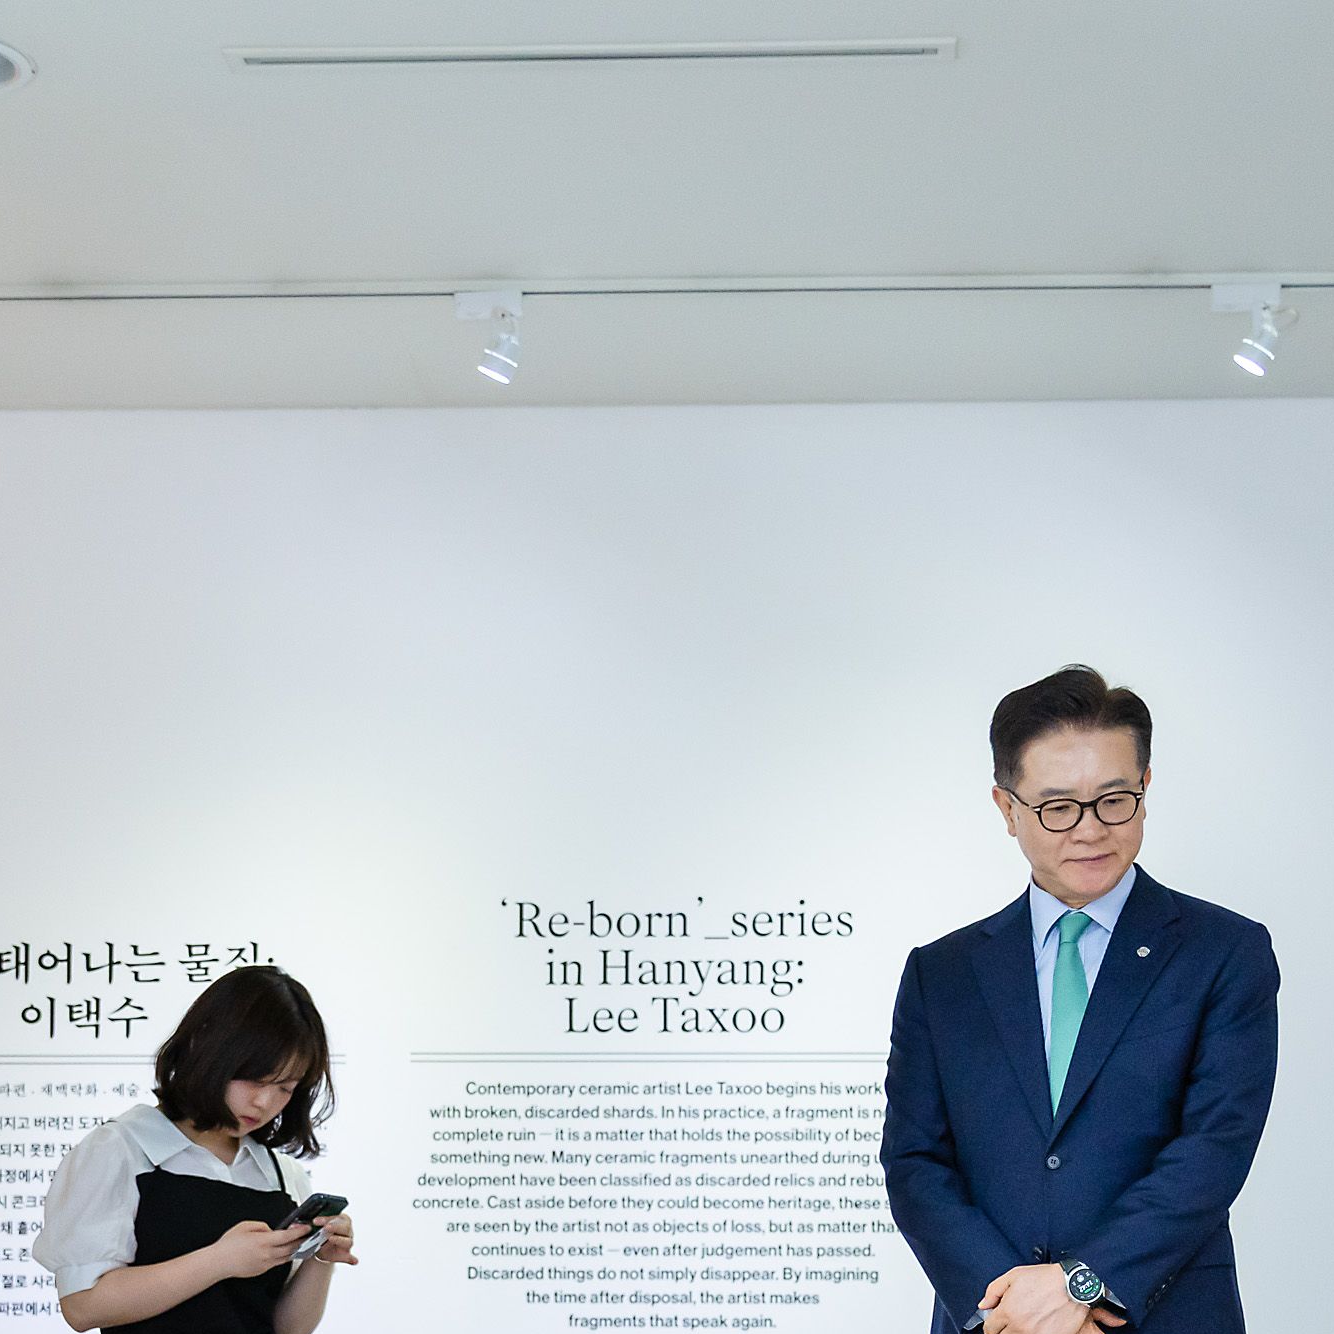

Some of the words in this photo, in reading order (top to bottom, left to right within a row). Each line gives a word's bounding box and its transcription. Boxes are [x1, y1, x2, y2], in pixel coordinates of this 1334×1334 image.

[546, 947, 585, 986] in
[598, 948, 805, 997] Hanyang:
[21, 993, 149, 1039] 이택수
[564, 996, 639, 1033] Lee
[651, 997, 786, 1033] Taxoo
[466, 1081, 575, 1098] Contemporary
[579, 1081, 639, 1095] ceramic
[643, 1082, 681, 1095] artist
[686, 1082, 713, 1095] Lee
[717, 1081, 762, 1095] Taxoo
[766, 1082, 816, 1098] begins
[820, 1082, 841, 1095] his
[845, 1082, 882, 1095] work
[430, 1106, 461, 1118] with
[465, 1105, 521, 1120] broken,
[524, 1105, 599, 1119] discarded
[603, 1105, 657, 1119] shards.
[662, 1105, 674, 1118] In
[678, 1106, 700, 1119] his
[703, 1106, 769, 1121] practice,
[773, 1109, 781, 1119] a
[785, 1106, 853, 1122] fragment
[858, 1106, 869, 1119] is
[34, 1116, 73, 1130] 버려진
[79, 1117, 104, 1131] 도자
[432, 1127, 505, 1145] complete
[506, 1127, 536, 1144] ruin
[554, 1127, 565, 1142] it
[567, 1127, 581, 1143] is
[582, 1130, 592, 1144] a
[594, 1128, 646, 1142] matter
[648, 1128, 678, 1142] that
[681, 1128, 723, 1142] holds
[726, 1128, 751, 1142] the
[754, 1128, 831, 1144] possibility
[834, 1128, 850, 1144] of
[30, 1143, 55, 1158] 못한
[60, 1144, 72, 1157] 잔
[430, 1150, 510, 1167] something
[514, 1153, 548, 1164] new.
[552, 1150, 591, 1167] Many
[595, 1151, 655, 1164] ceramic
[660, 1150, 737, 1167] fragments
[741, 1151, 818, 1164] unearthed
[822, 1151, 870, 1167] during
[418, 1173, 516, 1189] development
[520, 1173, 555, 1187] have
[559, 1173, 597, 1187] been
[600, 1173, 671, 1187] classified
[675, 1176, 692, 1187] as
[695, 1173, 770, 1187] discarded
[774, 1173, 815, 1187] relics
[819, 1174, 846, 1187] and
[413, 1196, 483, 1209] concrete.
[487, 1195, 521, 1209] Cast
[525, 1196, 565, 1209] aside
[568, 1195, 618, 1209] before
[621, 1196, 653, 1212] they
[657, 1196, 699, 1209] could
[703, 1196, 765, 1209] become
[768, 1196, 835, 1212] heritage,
[839, 1196, 881, 1210] these
[0, 1221, 13, 1235] 채
[447, 1222, 470, 1232] are
[474, 1222, 510, 1233] seen
[514, 1219, 531, 1235] by
[535, 1219, 559, 1233] the
[562, 1219, 600, 1233] artist
[604, 1220, 628, 1232] not
[632, 1222, 649, 1233] as
[652, 1219, 709, 1235] objects
[712, 1220, 727, 1233] of
[731, 1220, 765, 1234] loss,
[769, 1220, 793, 1233] but
[797, 1223, 814, 1233] as
[818, 1221, 868, 1233] matter
[871, 1219, 898, 1233] tha
[470, 1242, 546, 1257] continues
[548, 1243, 565, 1257] to
[566, 1243, 603, 1257] exist
[623, 1246, 659, 1257] even
[661, 1243, 699, 1257] after
[700, 1243, 783, 1260] judgement
[786, 1243, 813, 1257] has
[816, 1243, 876, 1260] passed.
[468, 1266, 544, 1280] Discarded
[548, 1267, 594, 1283] things
[597, 1267, 617, 1280] do
[620, 1268, 644, 1280] not
[648, 1267, 697, 1283] simply
[700, 1267, 778, 1283] disappear.
[783, 1267, 801, 1283] By
[805, 1267, 879, 1284] imagining
[527, 1290, 550, 1304] the
[554, 1291, 586, 1303] time
[590, 1290, 625, 1304] after
[629, 1291, 696, 1307] disposal,
[700, 1291, 724, 1304] the
[728, 1291, 766, 1304] artist
[770, 1291, 819, 1304] makes
[569, 1314, 646, 1330] fragments
[650, 1314, 678, 1328] that
[682, 1315, 728, 1330] speak
[732, 1315, 776, 1331] again.
